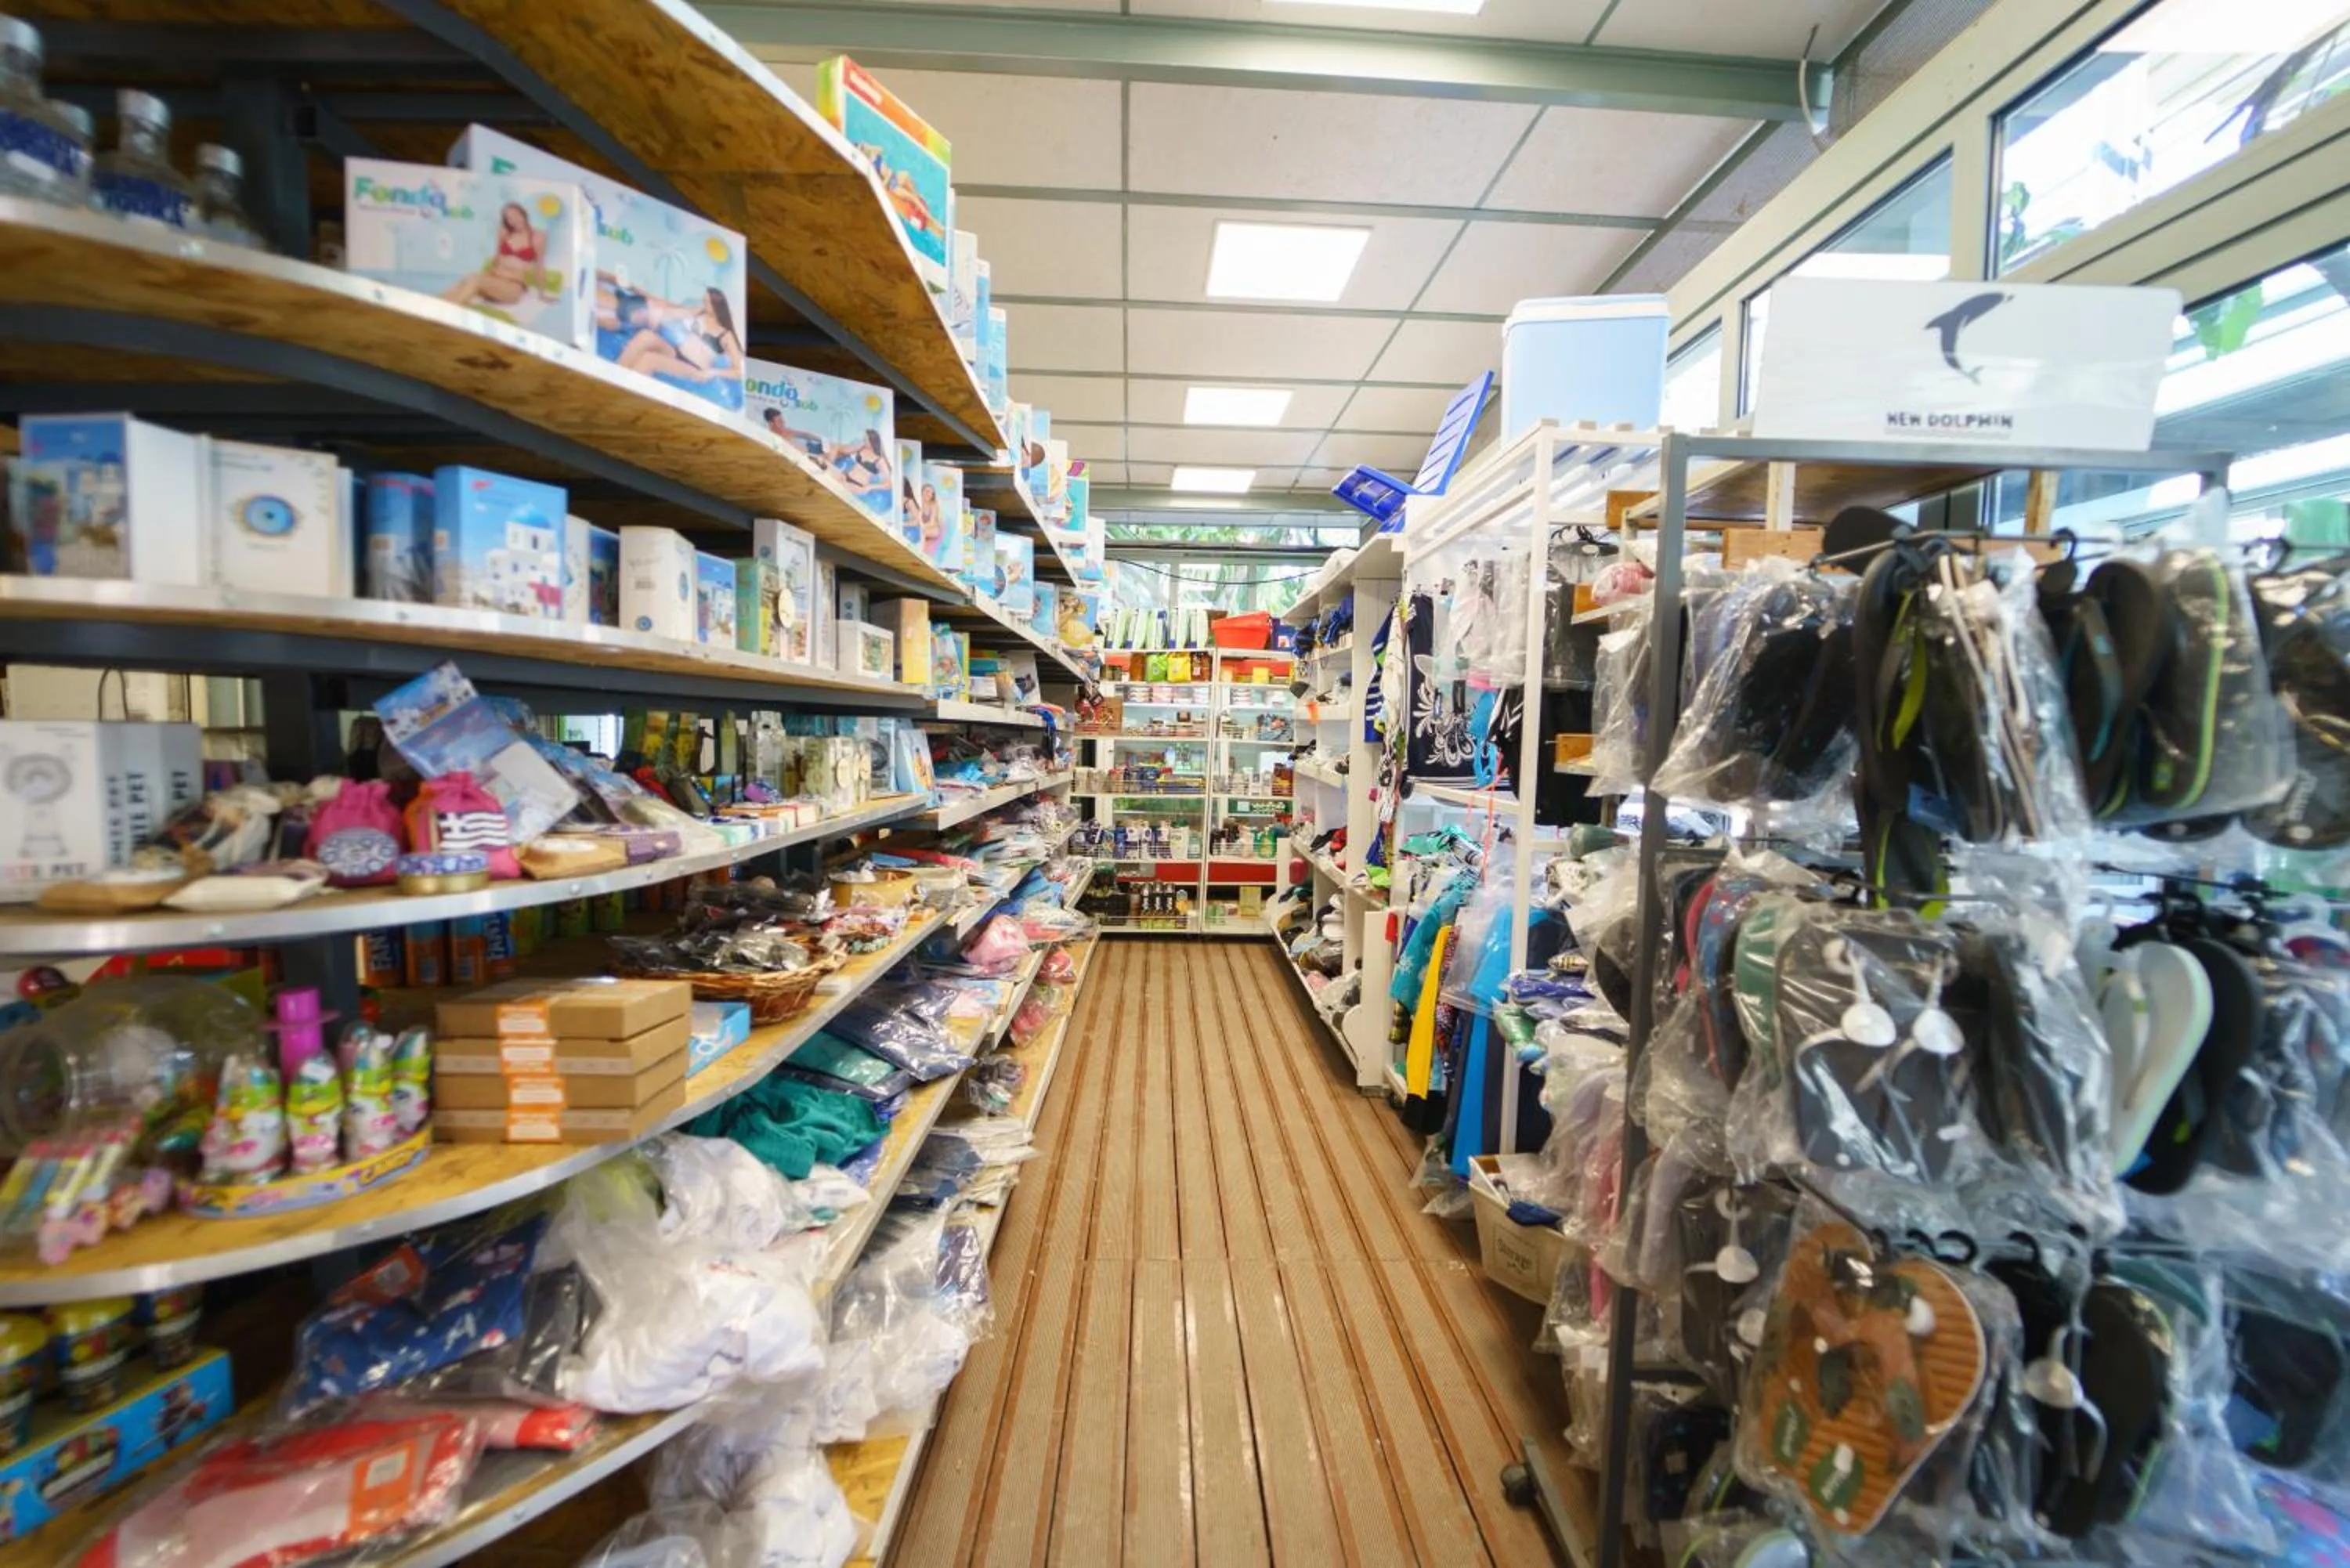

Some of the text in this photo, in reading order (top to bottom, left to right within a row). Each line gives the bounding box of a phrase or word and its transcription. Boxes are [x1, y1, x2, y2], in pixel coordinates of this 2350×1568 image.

[745, 376, 799, 400] ondo
[1887, 412, 2013, 429] NEW DOLPHIN
[126, 770, 145, 804] PET
[172, 770, 189, 800] PET
